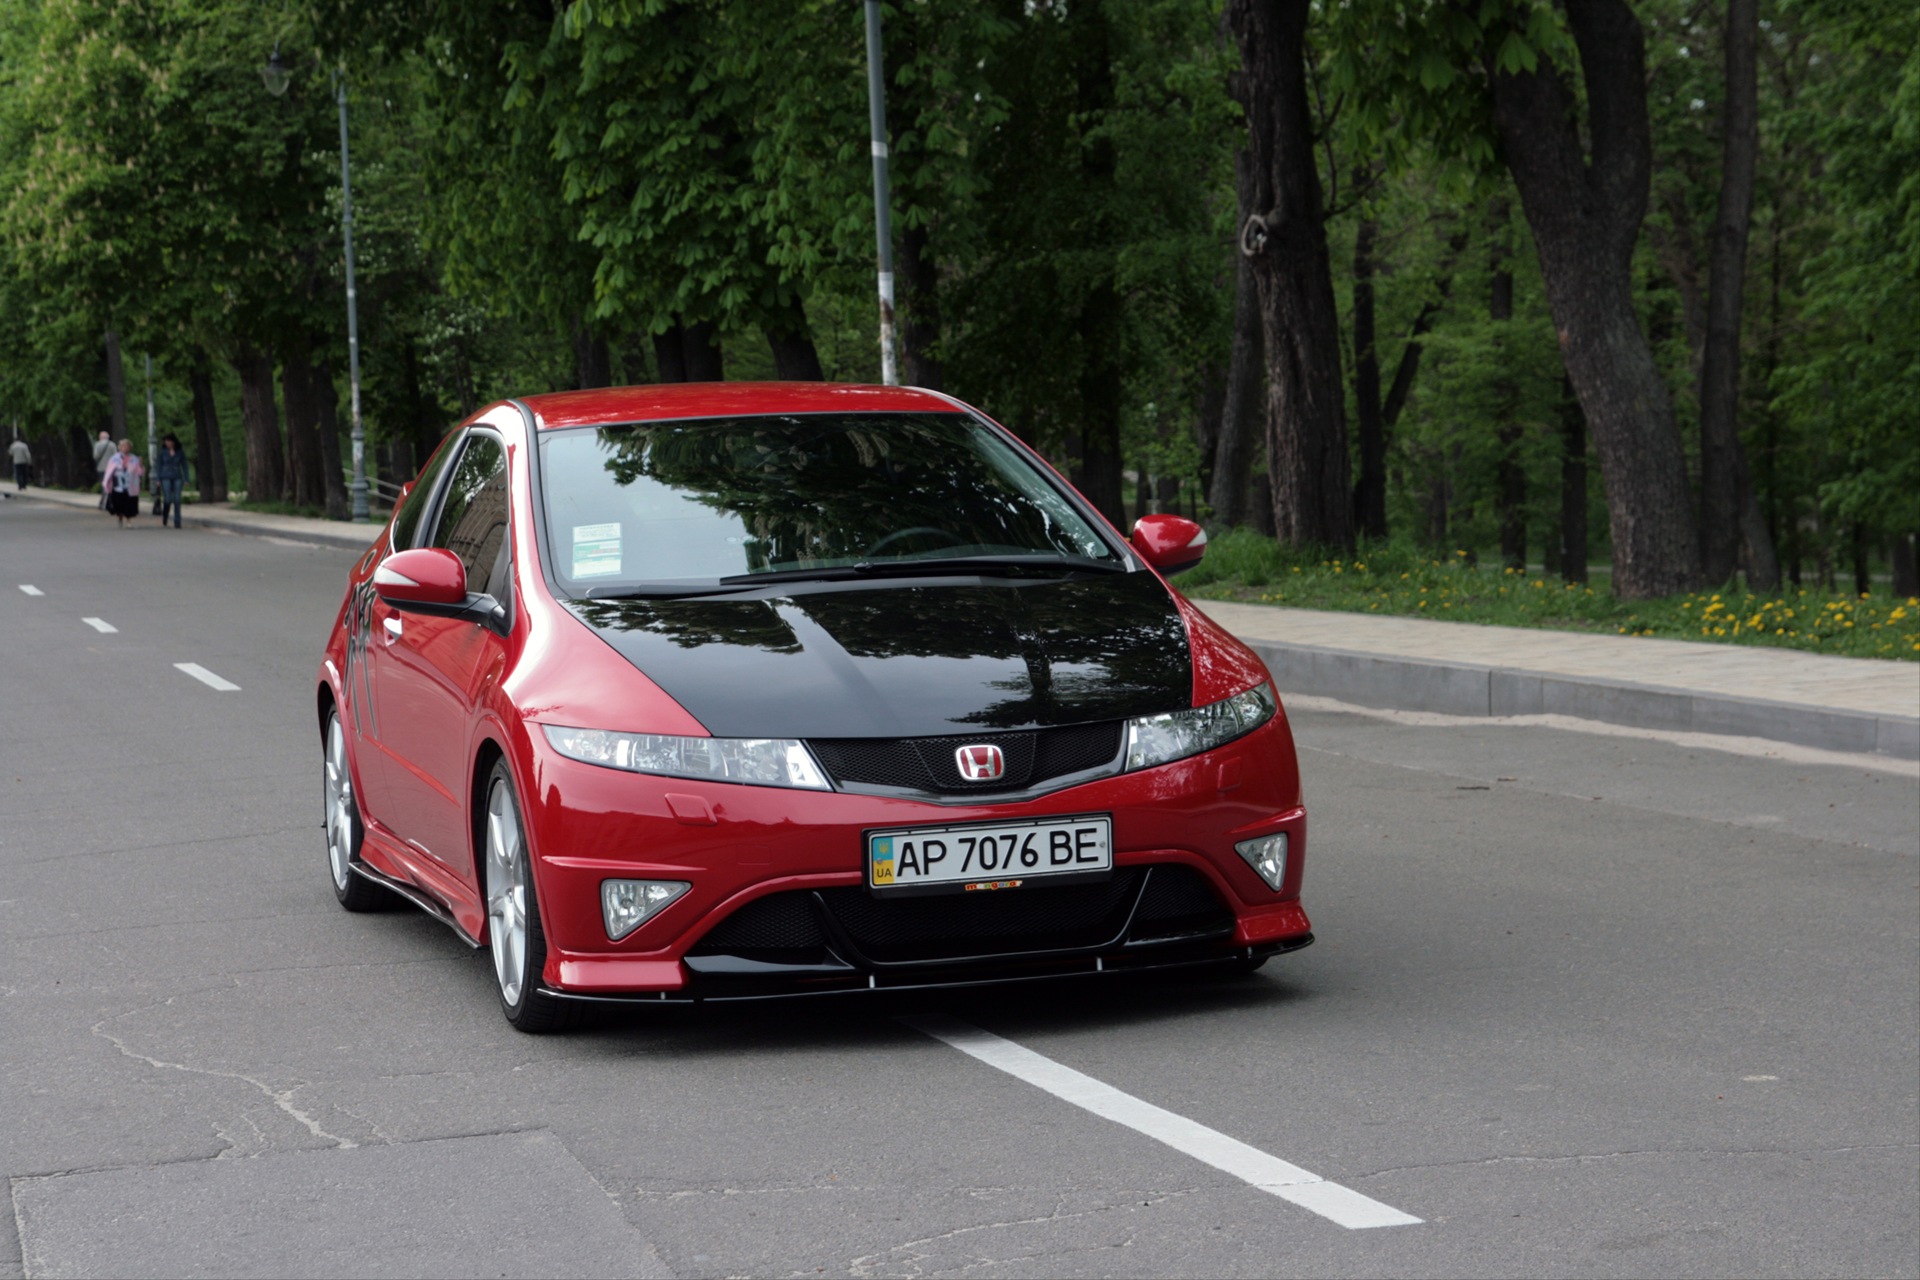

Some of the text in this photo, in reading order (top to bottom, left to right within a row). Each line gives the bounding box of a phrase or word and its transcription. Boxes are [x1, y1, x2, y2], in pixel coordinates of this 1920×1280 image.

[896, 827, 1099, 877] AP 7076 BE
[876, 867, 892, 878] UA
